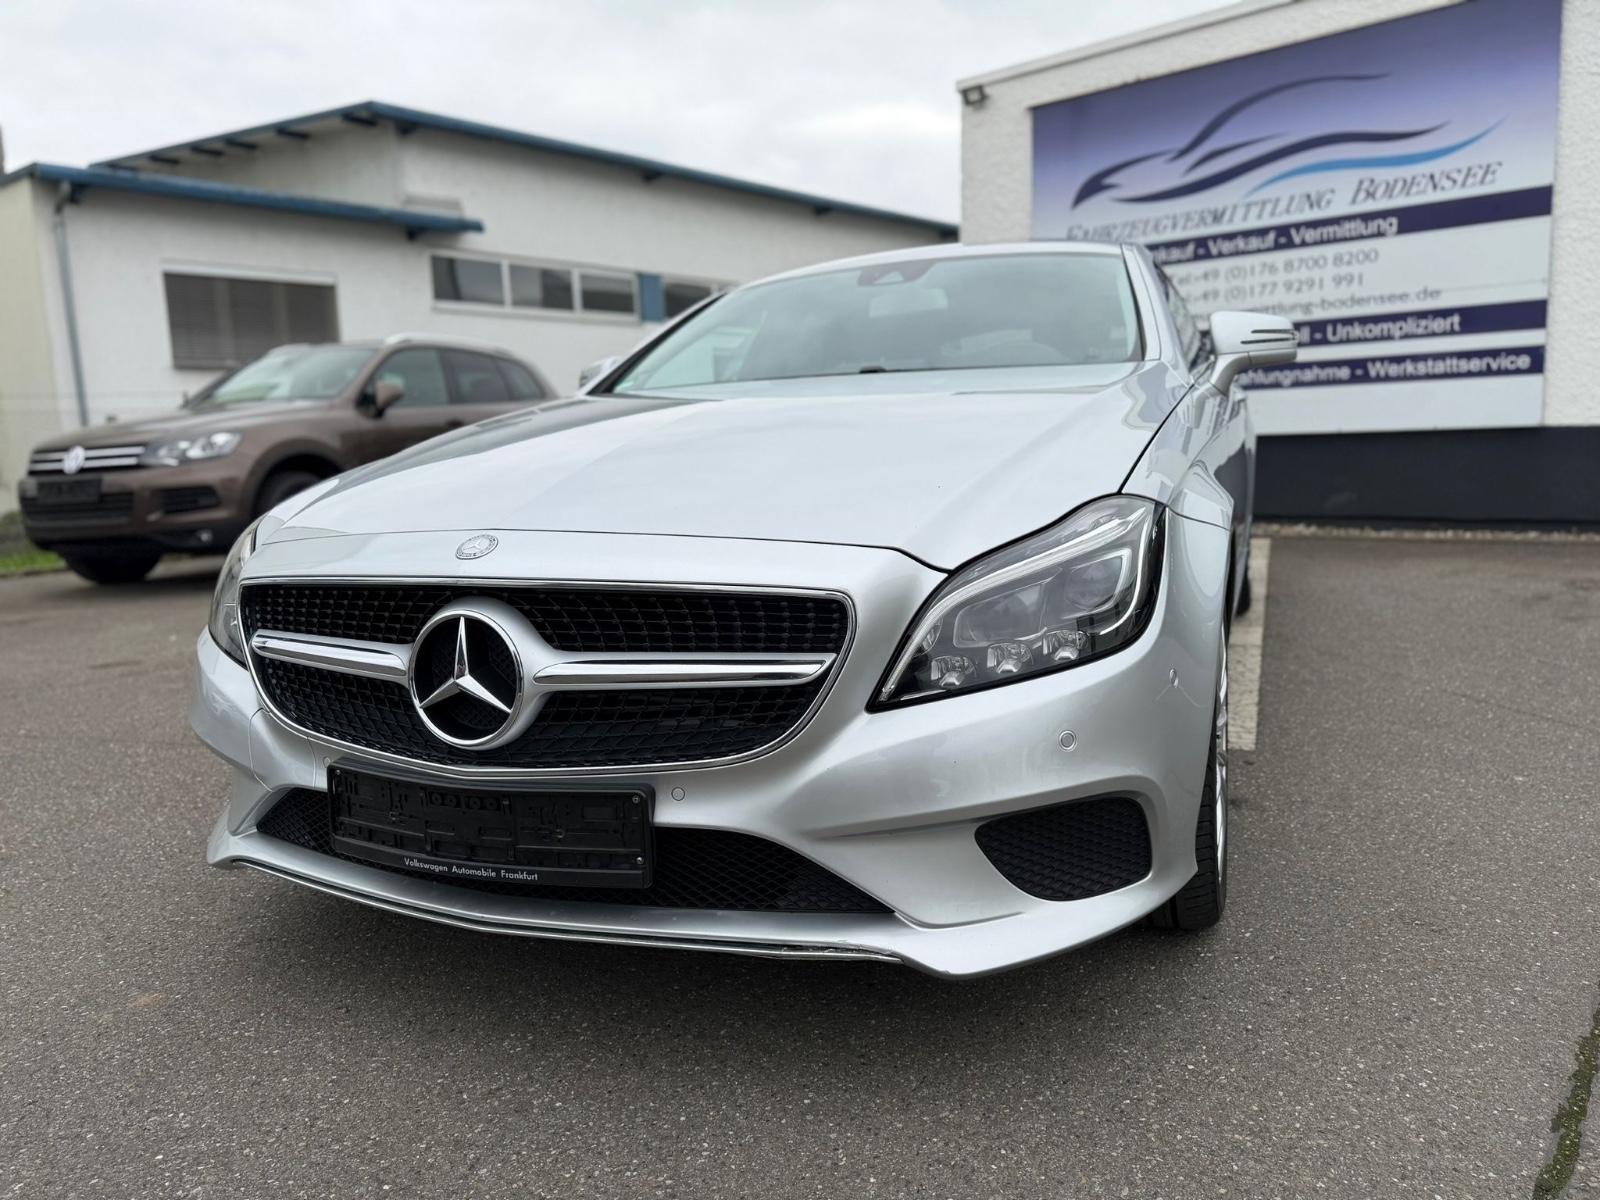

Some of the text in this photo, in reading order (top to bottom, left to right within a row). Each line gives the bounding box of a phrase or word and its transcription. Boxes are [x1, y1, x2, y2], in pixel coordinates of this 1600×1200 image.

[1351, 161, 1502, 205] BODENSEE
[1153, 240, 1195, 264] nkauf
[1208, 231, 1275, 257] Verkauf
[1290, 216, 1398, 246] Vermittlung
[1283, 254, 1328, 274] 8700
[1332, 249, 1379, 267] 8200
[1285, 276, 1324, 293] 9291
[1332, 272, 1364, 288] 991
[1326, 313, 1461, 342] Unkompliziert
[1368, 352, 1531, 379] Werkstattservice
[404, 857, 538, 881] Volkswagen Automobile Frankfurt
